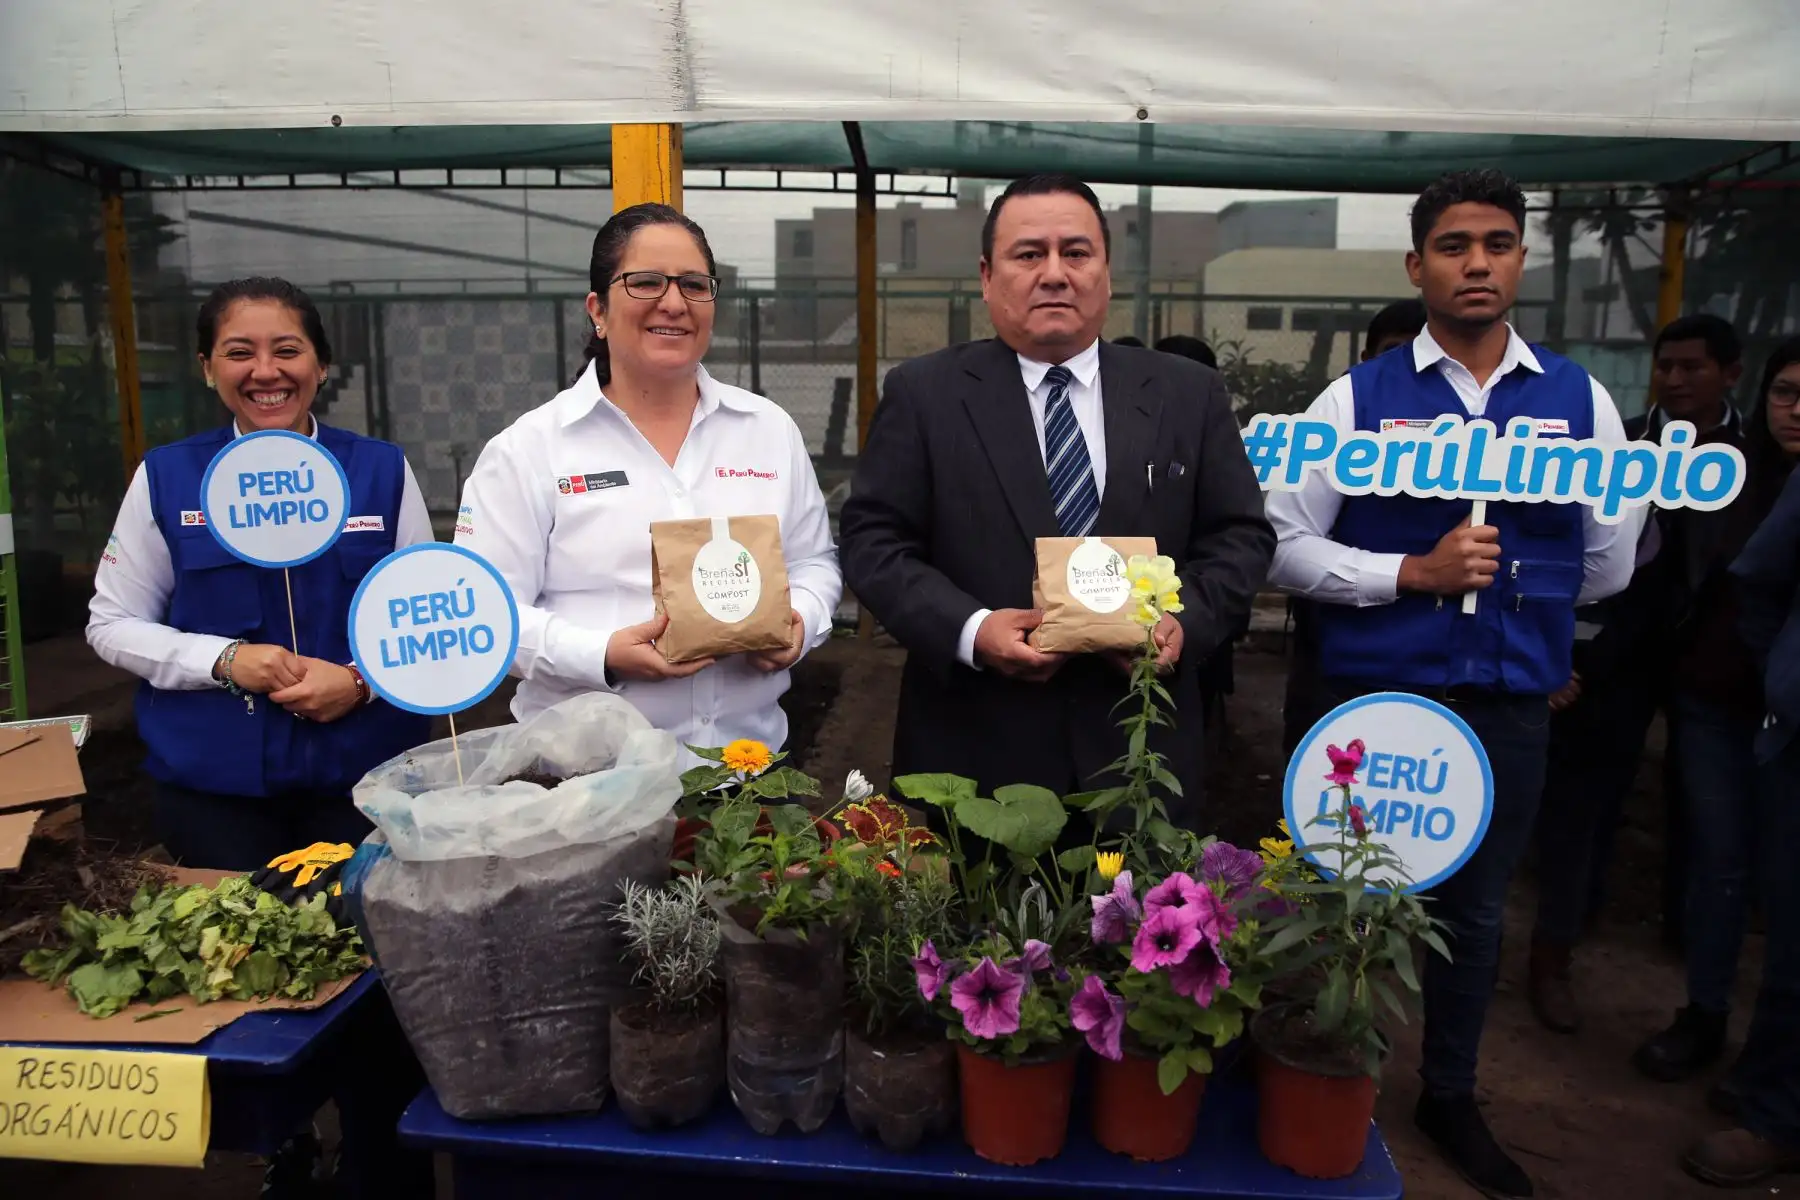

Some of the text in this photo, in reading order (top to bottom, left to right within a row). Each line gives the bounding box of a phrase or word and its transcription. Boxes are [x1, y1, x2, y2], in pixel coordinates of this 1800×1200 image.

[238, 460, 315, 498] PERÚ
[1243, 420, 1738, 517] #PerúLimpio
[228, 498, 329, 529] LIMPIO
[388, 577, 476, 629] PERÚ
[707, 589, 750, 600] COMPOST
[379, 624, 495, 669] LIMPIO
[1315, 788, 1456, 842] LMPIO
[16, 1057, 159, 1095] RESIDUOS
